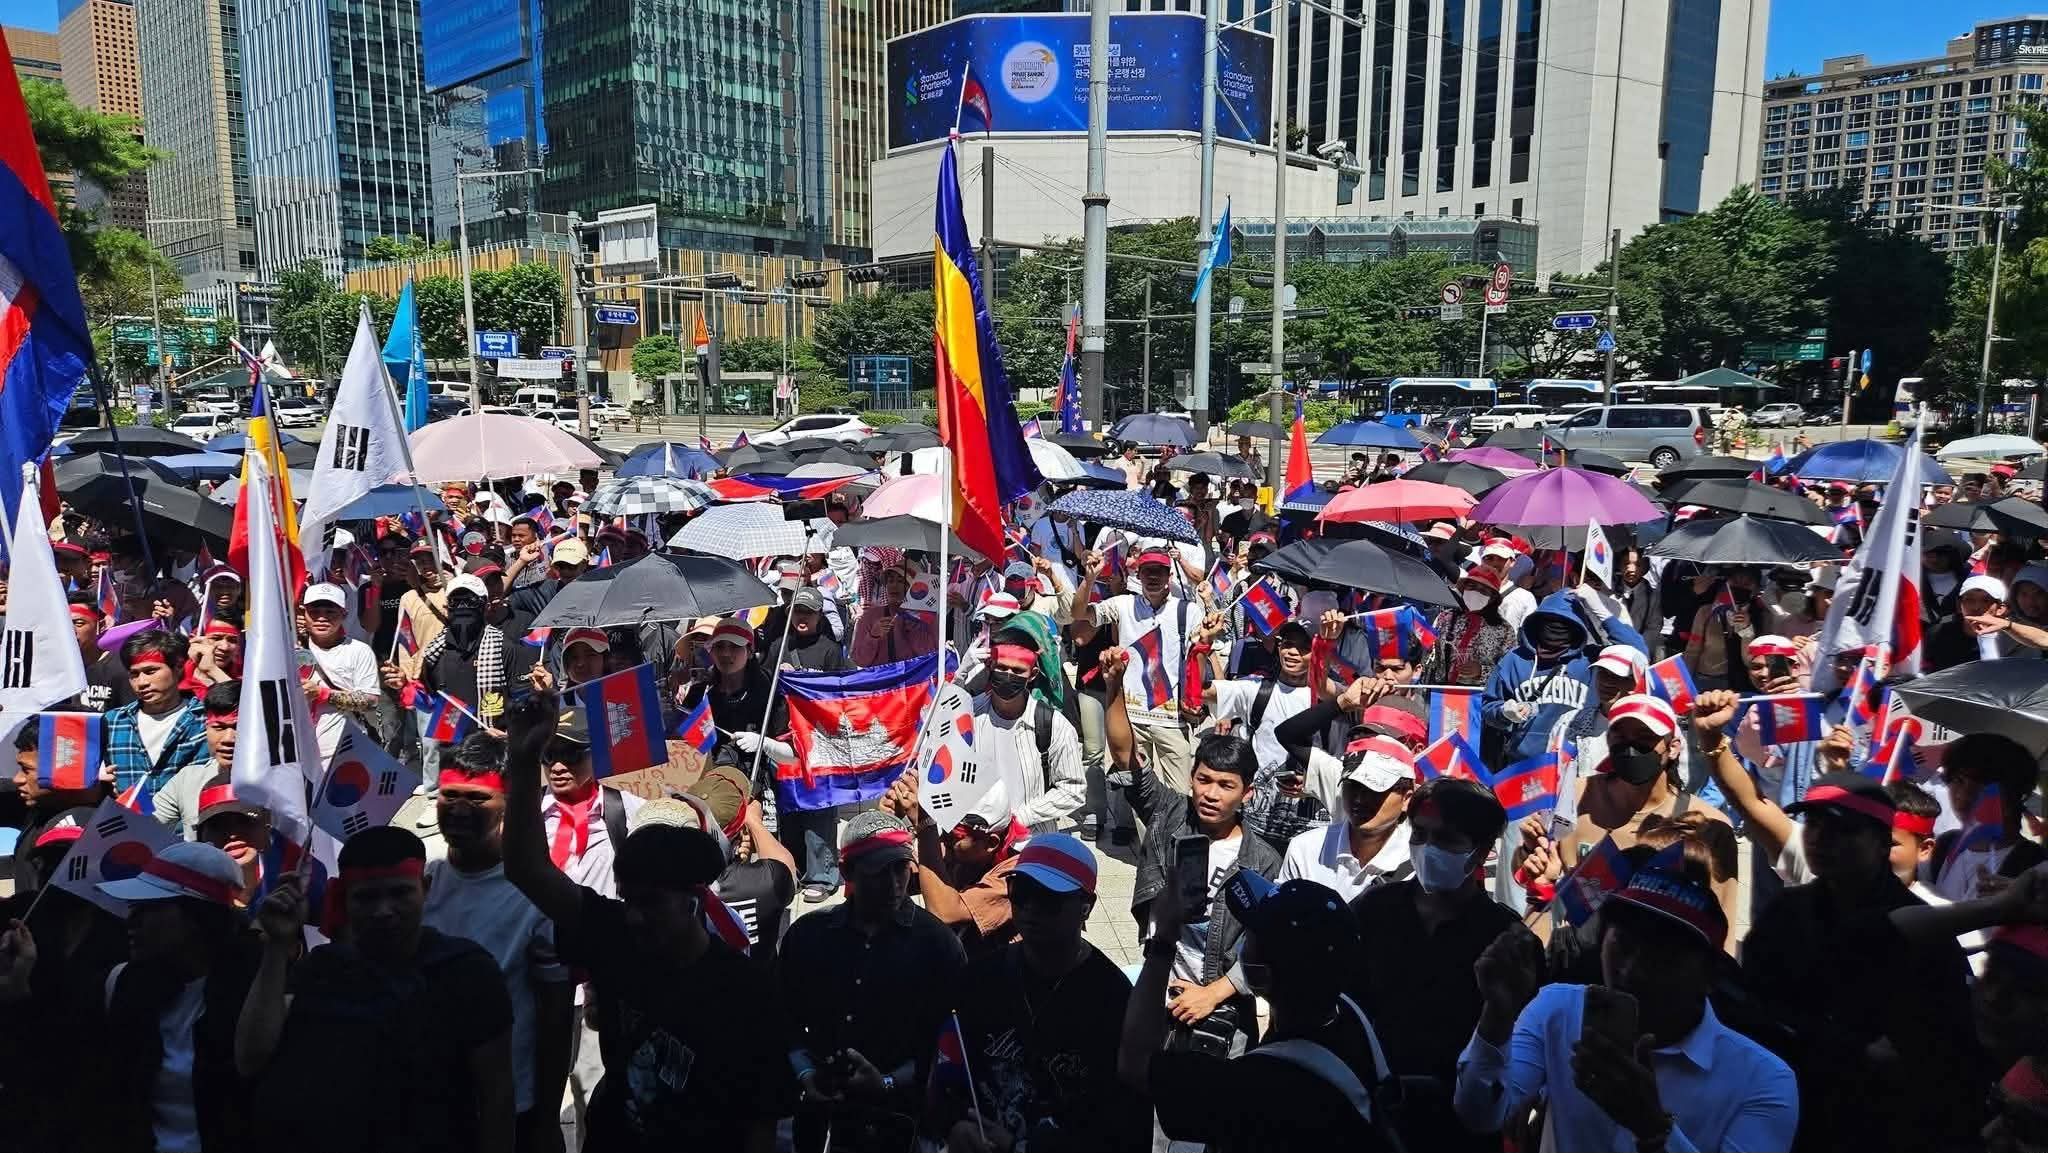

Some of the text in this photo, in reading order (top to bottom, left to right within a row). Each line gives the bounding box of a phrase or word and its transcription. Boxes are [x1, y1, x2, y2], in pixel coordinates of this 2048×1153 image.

[920, 69, 949, 84] standard
[920, 77, 951, 92] chartered
[1498, 271, 1507, 284] 50
[1514, 676, 1588, 711] RIZONA
